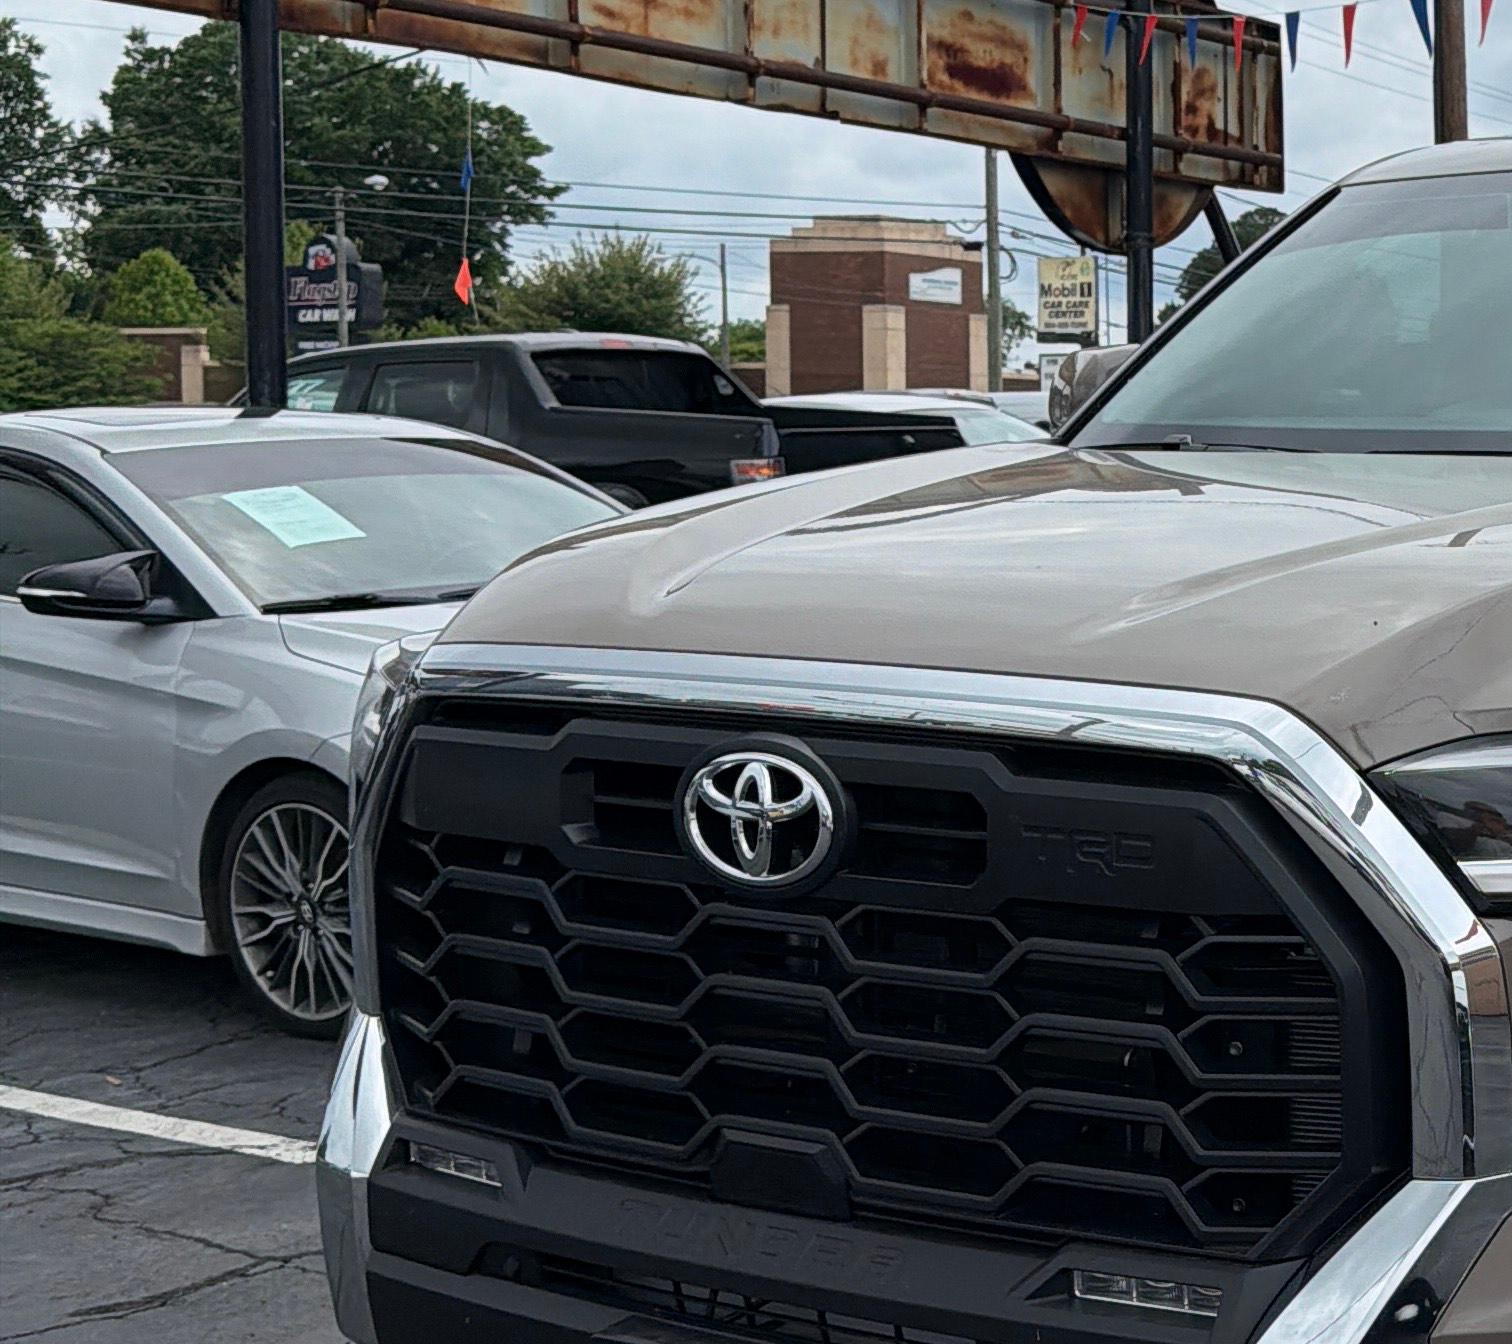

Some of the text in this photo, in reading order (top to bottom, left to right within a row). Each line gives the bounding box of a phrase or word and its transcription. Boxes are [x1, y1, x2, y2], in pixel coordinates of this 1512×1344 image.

[1041, 283, 1077, 298] Mobil
[1043, 300, 1090, 309] CAR CARE
[298, 309, 357, 323] CAR WAH
[1048, 310, 1086, 318] CENTER
